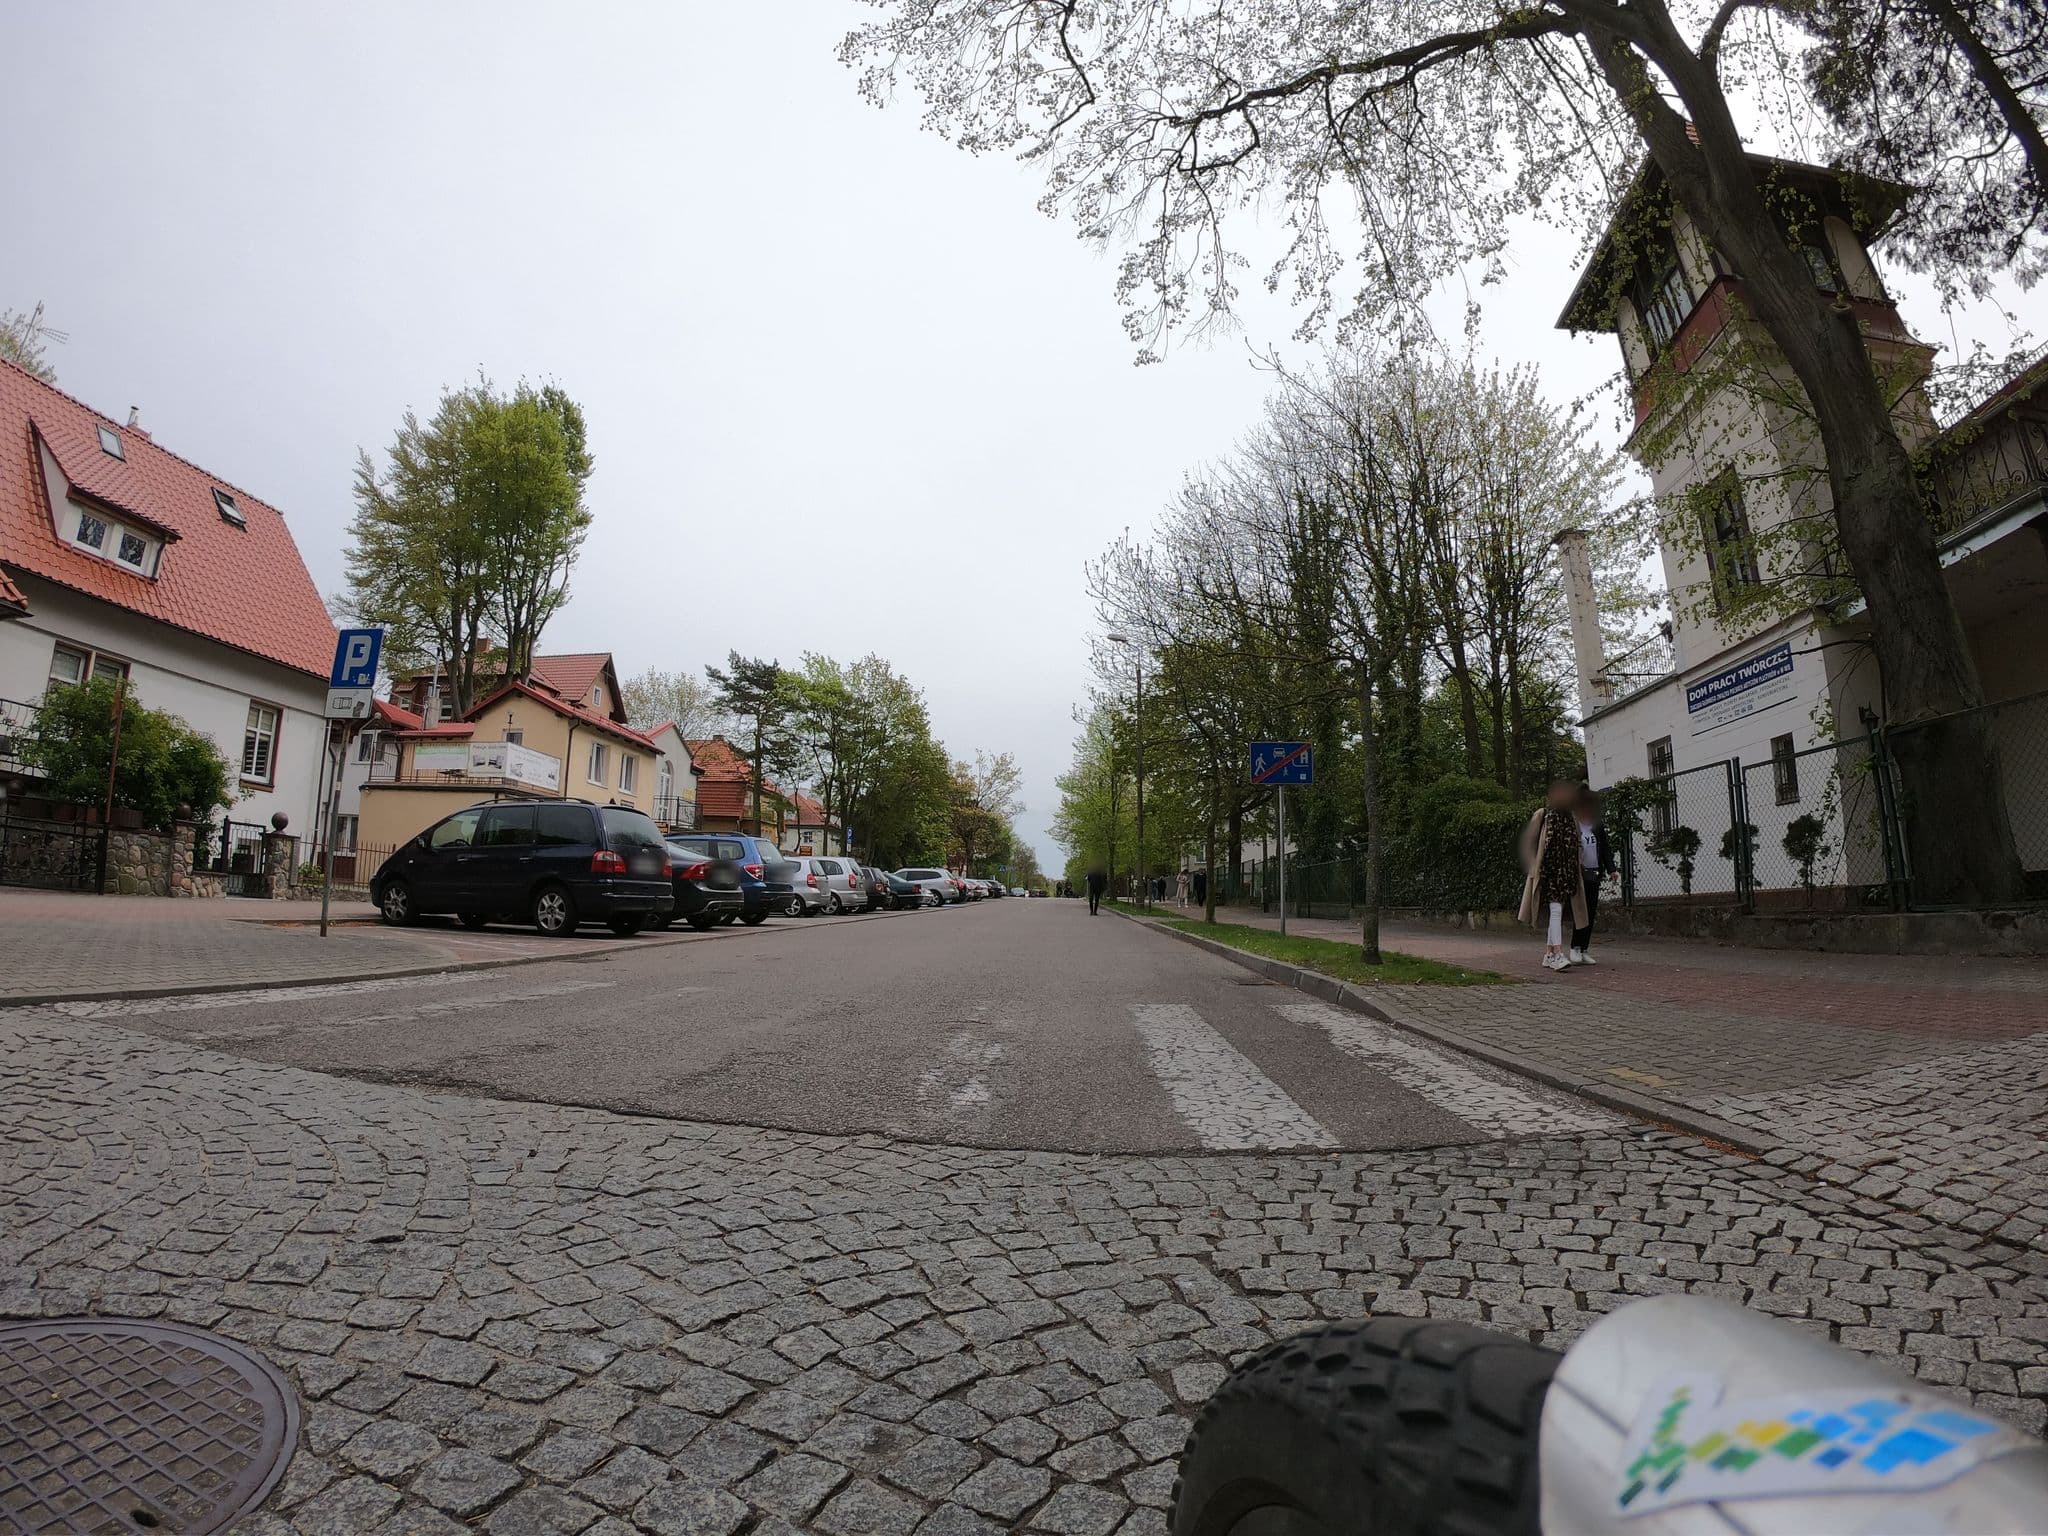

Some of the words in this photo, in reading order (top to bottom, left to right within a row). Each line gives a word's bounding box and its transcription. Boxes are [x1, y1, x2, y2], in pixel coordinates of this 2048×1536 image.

[341, 635, 372, 681] P
[1689, 686, 1708, 702] DOM
[1708, 673, 1737, 693] PRACY
[1738, 649, 1790, 680] TWÓRCZEJ
